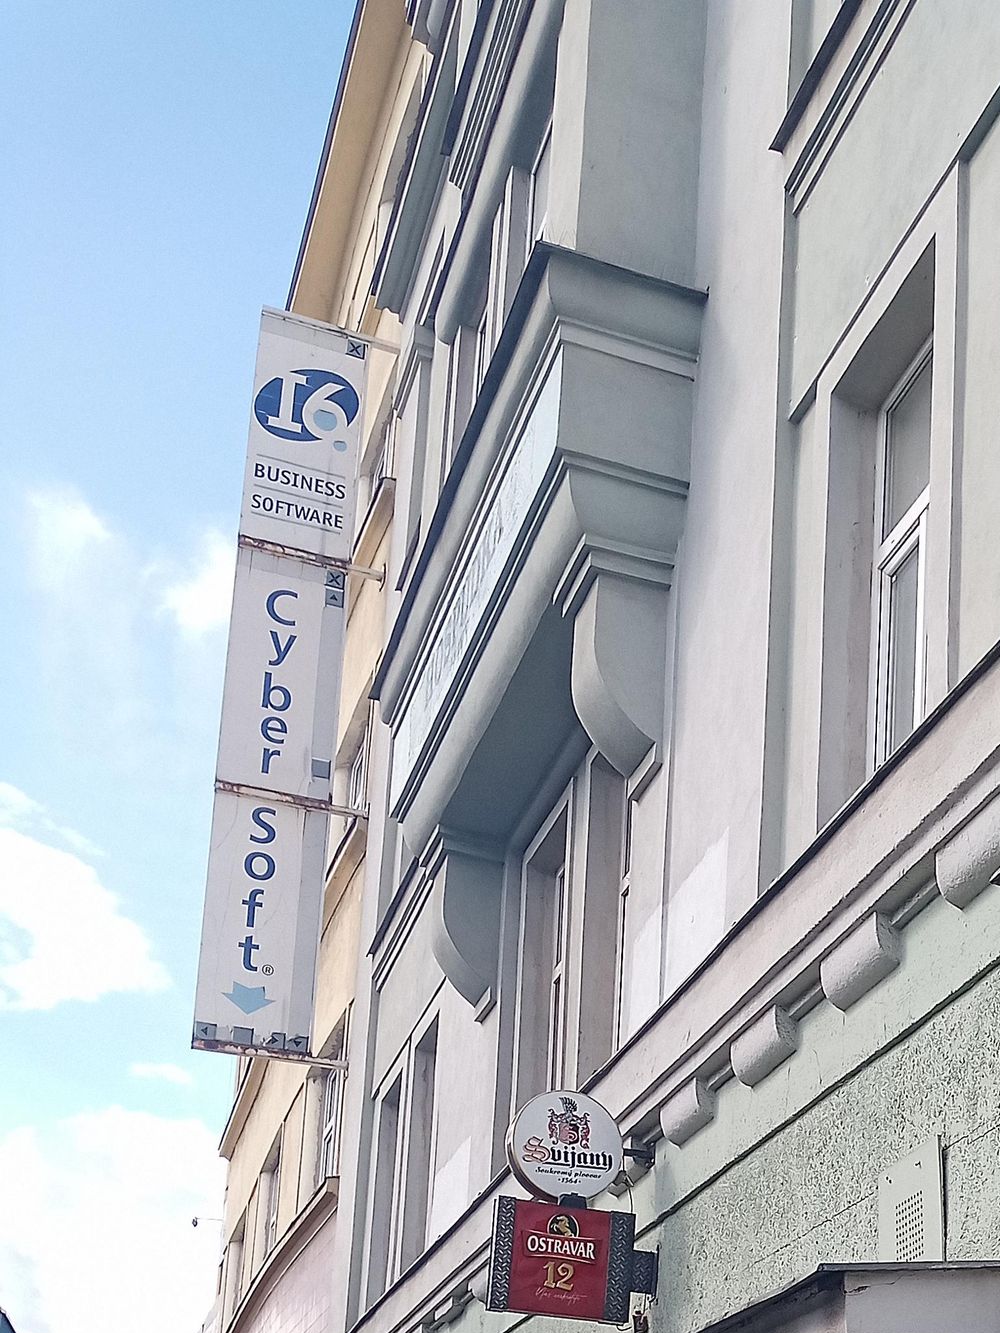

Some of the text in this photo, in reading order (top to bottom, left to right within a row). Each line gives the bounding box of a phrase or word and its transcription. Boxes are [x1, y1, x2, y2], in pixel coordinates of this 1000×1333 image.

[254, 463, 346, 500] BUSINESS
[251, 494, 344, 529] SOFTWARE
[260, 589, 298, 774] Cyber
[523, 1136, 613, 1170] Svijany
[527, 1235, 595, 1260] OSTRAVAR
[543, 1261, 575, 1291] 12
